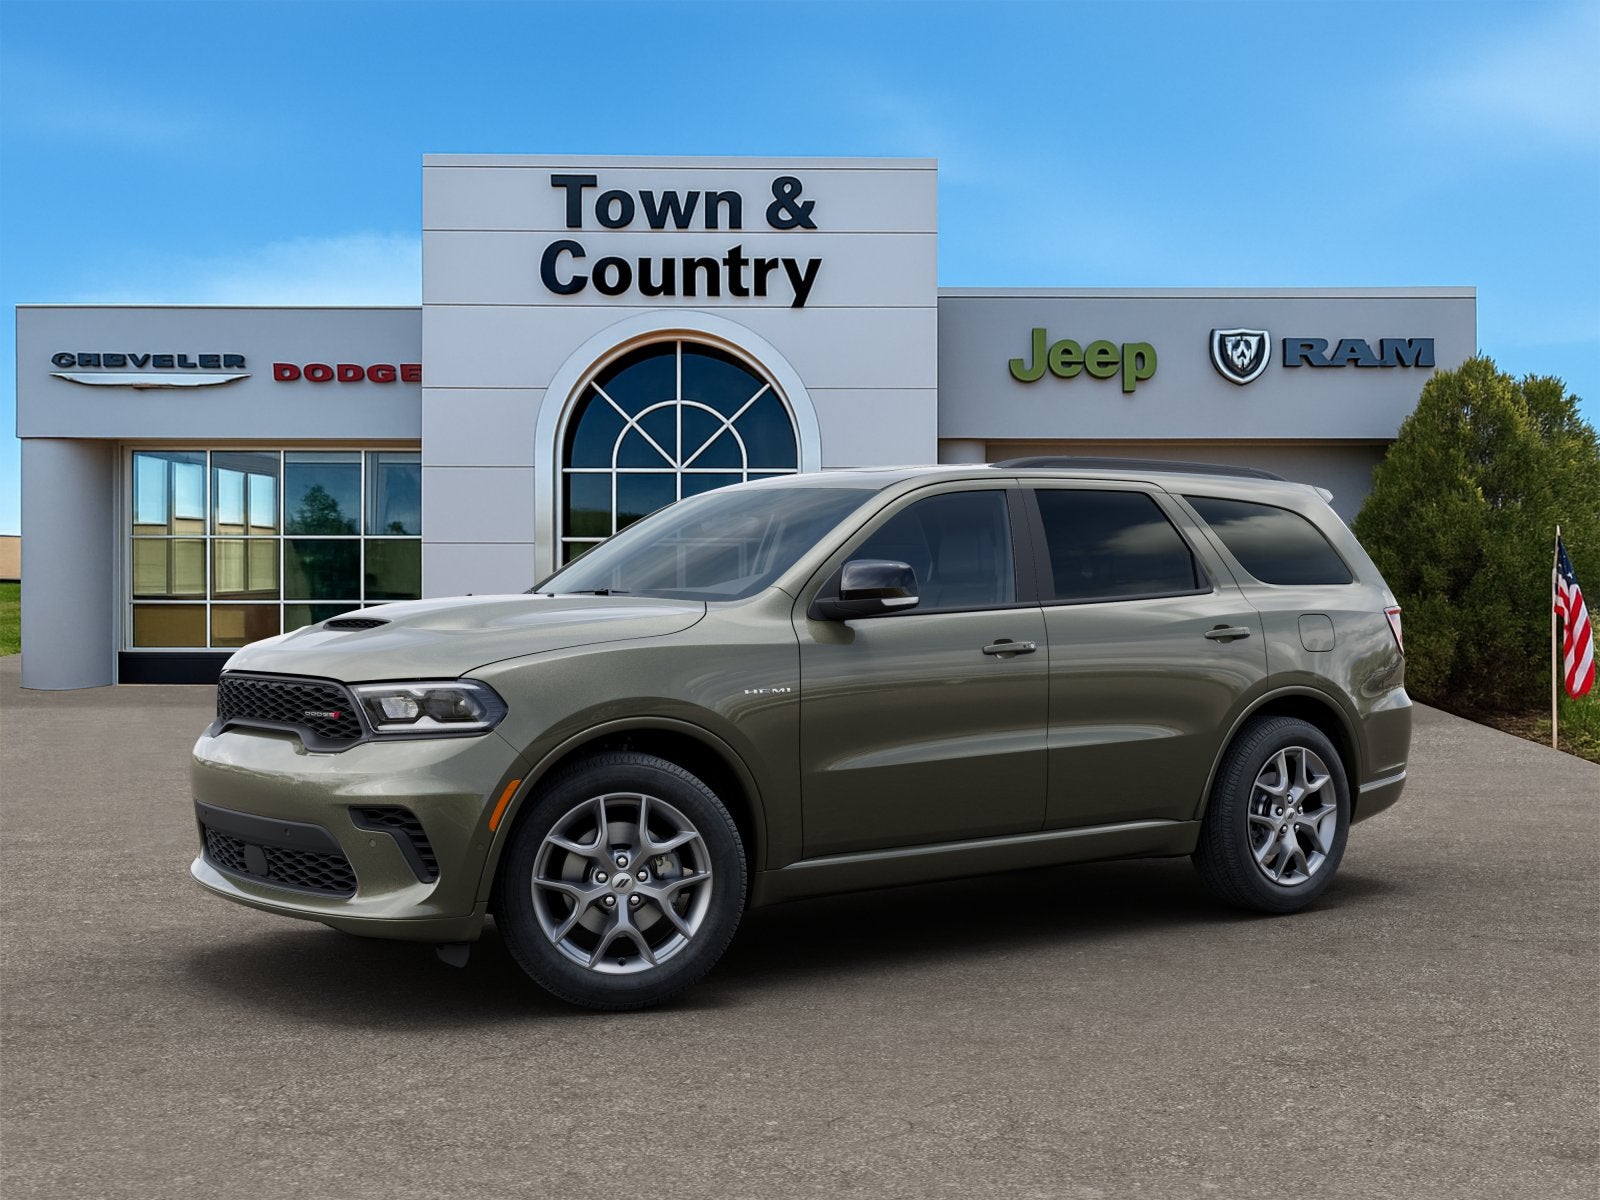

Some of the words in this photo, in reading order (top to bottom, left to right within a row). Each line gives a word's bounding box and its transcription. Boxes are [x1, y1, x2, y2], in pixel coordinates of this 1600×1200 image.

[550, 174, 743, 230] Town
[765, 175, 818, 230] &
[540, 239, 823, 308] Country
[273, 363, 423, 383] DODGE
[1009, 328, 1158, 393] Jeep
[1282, 337, 1436, 368] RAM
[744, 687, 791, 695] HEMI
